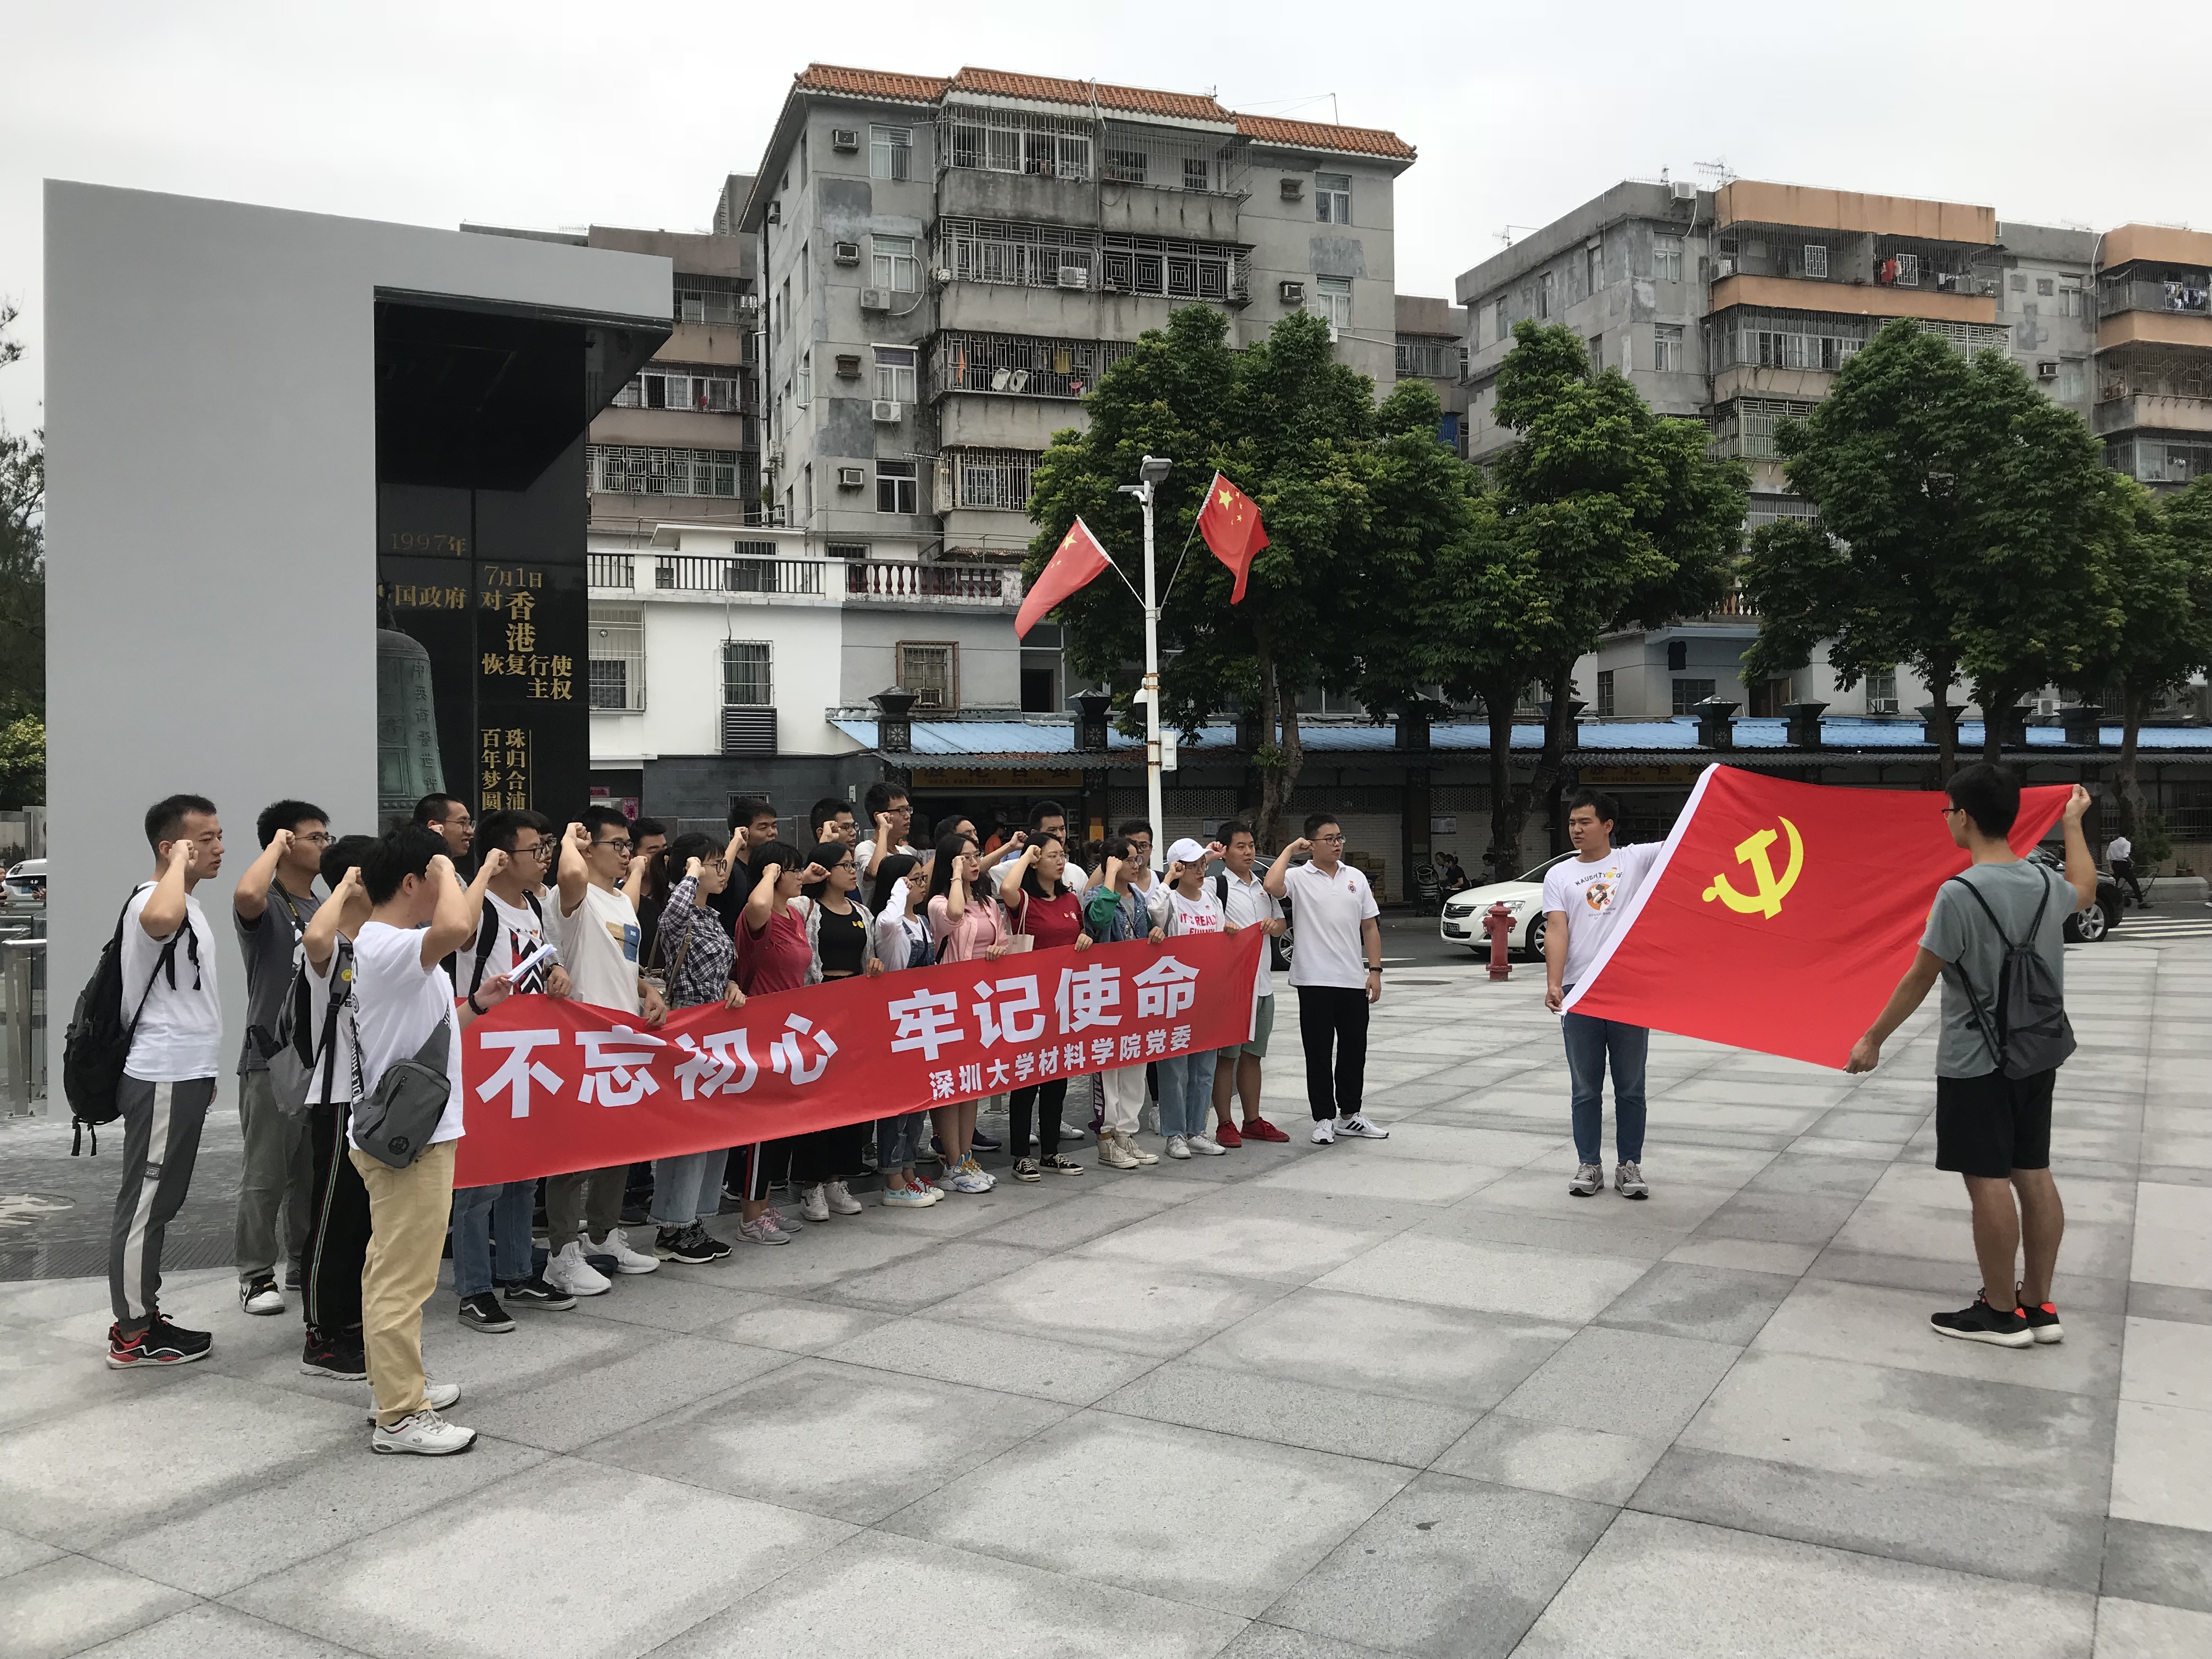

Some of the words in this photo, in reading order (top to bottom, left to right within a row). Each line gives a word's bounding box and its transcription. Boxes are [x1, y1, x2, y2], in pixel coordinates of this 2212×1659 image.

[391, 533, 466, 556] 1997年
[484, 565, 543, 588] 7月1日
[482, 653, 573, 676] 恢复行使
[527, 678, 572, 700] 主权
[481, 728, 501, 811] 百年梦圆
[505, 728, 526, 810] 珠归合浦
[888, 955, 1200, 1062] 牢记使命
[476, 1013, 839, 1119] 不忘初心
[928, 1024, 1193, 1101] 深圳大学材料学院党委
